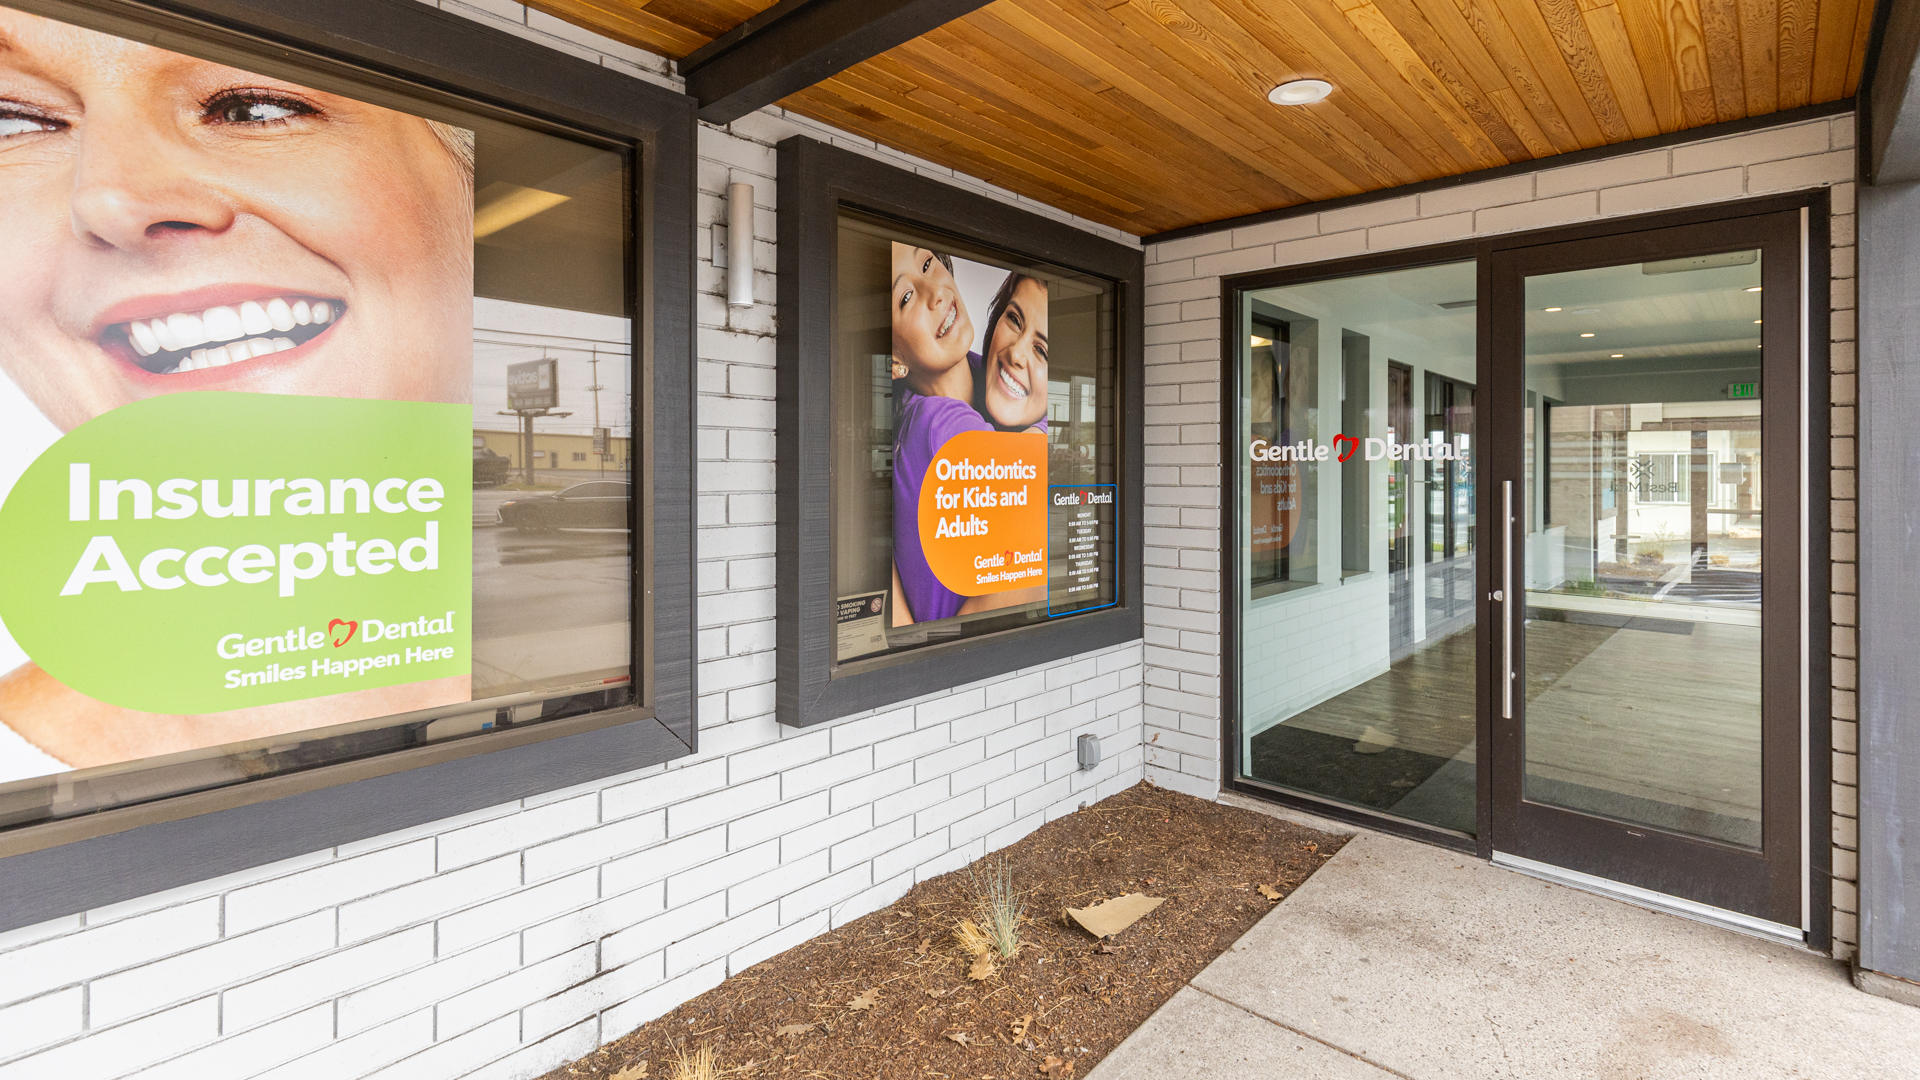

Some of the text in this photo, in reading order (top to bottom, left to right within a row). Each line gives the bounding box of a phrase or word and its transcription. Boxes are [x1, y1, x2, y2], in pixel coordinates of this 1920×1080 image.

[1733, 383, 1755, 397] EXIT
[1250, 436, 1464, 462] Gentle Dental
[936, 458, 1036, 480] Orthodontics
[70, 463, 444, 521] Insurance
[935, 485, 1027, 509] for Kids and
[1054, 492, 1112, 505] Gentle Dental
[935, 514, 988, 538] Adults
[60, 520, 438, 597] Accepted
[974, 549, 1042, 569] Gentle Dental
[976, 568, 1042, 584] Smiles Happen Here
[840, 600, 866, 609] SMOKING
[840, 606, 860, 616] VAPING
[216, 611, 454, 659] Gentle Dental
[224, 646, 454, 689] Smiles Happen Here
